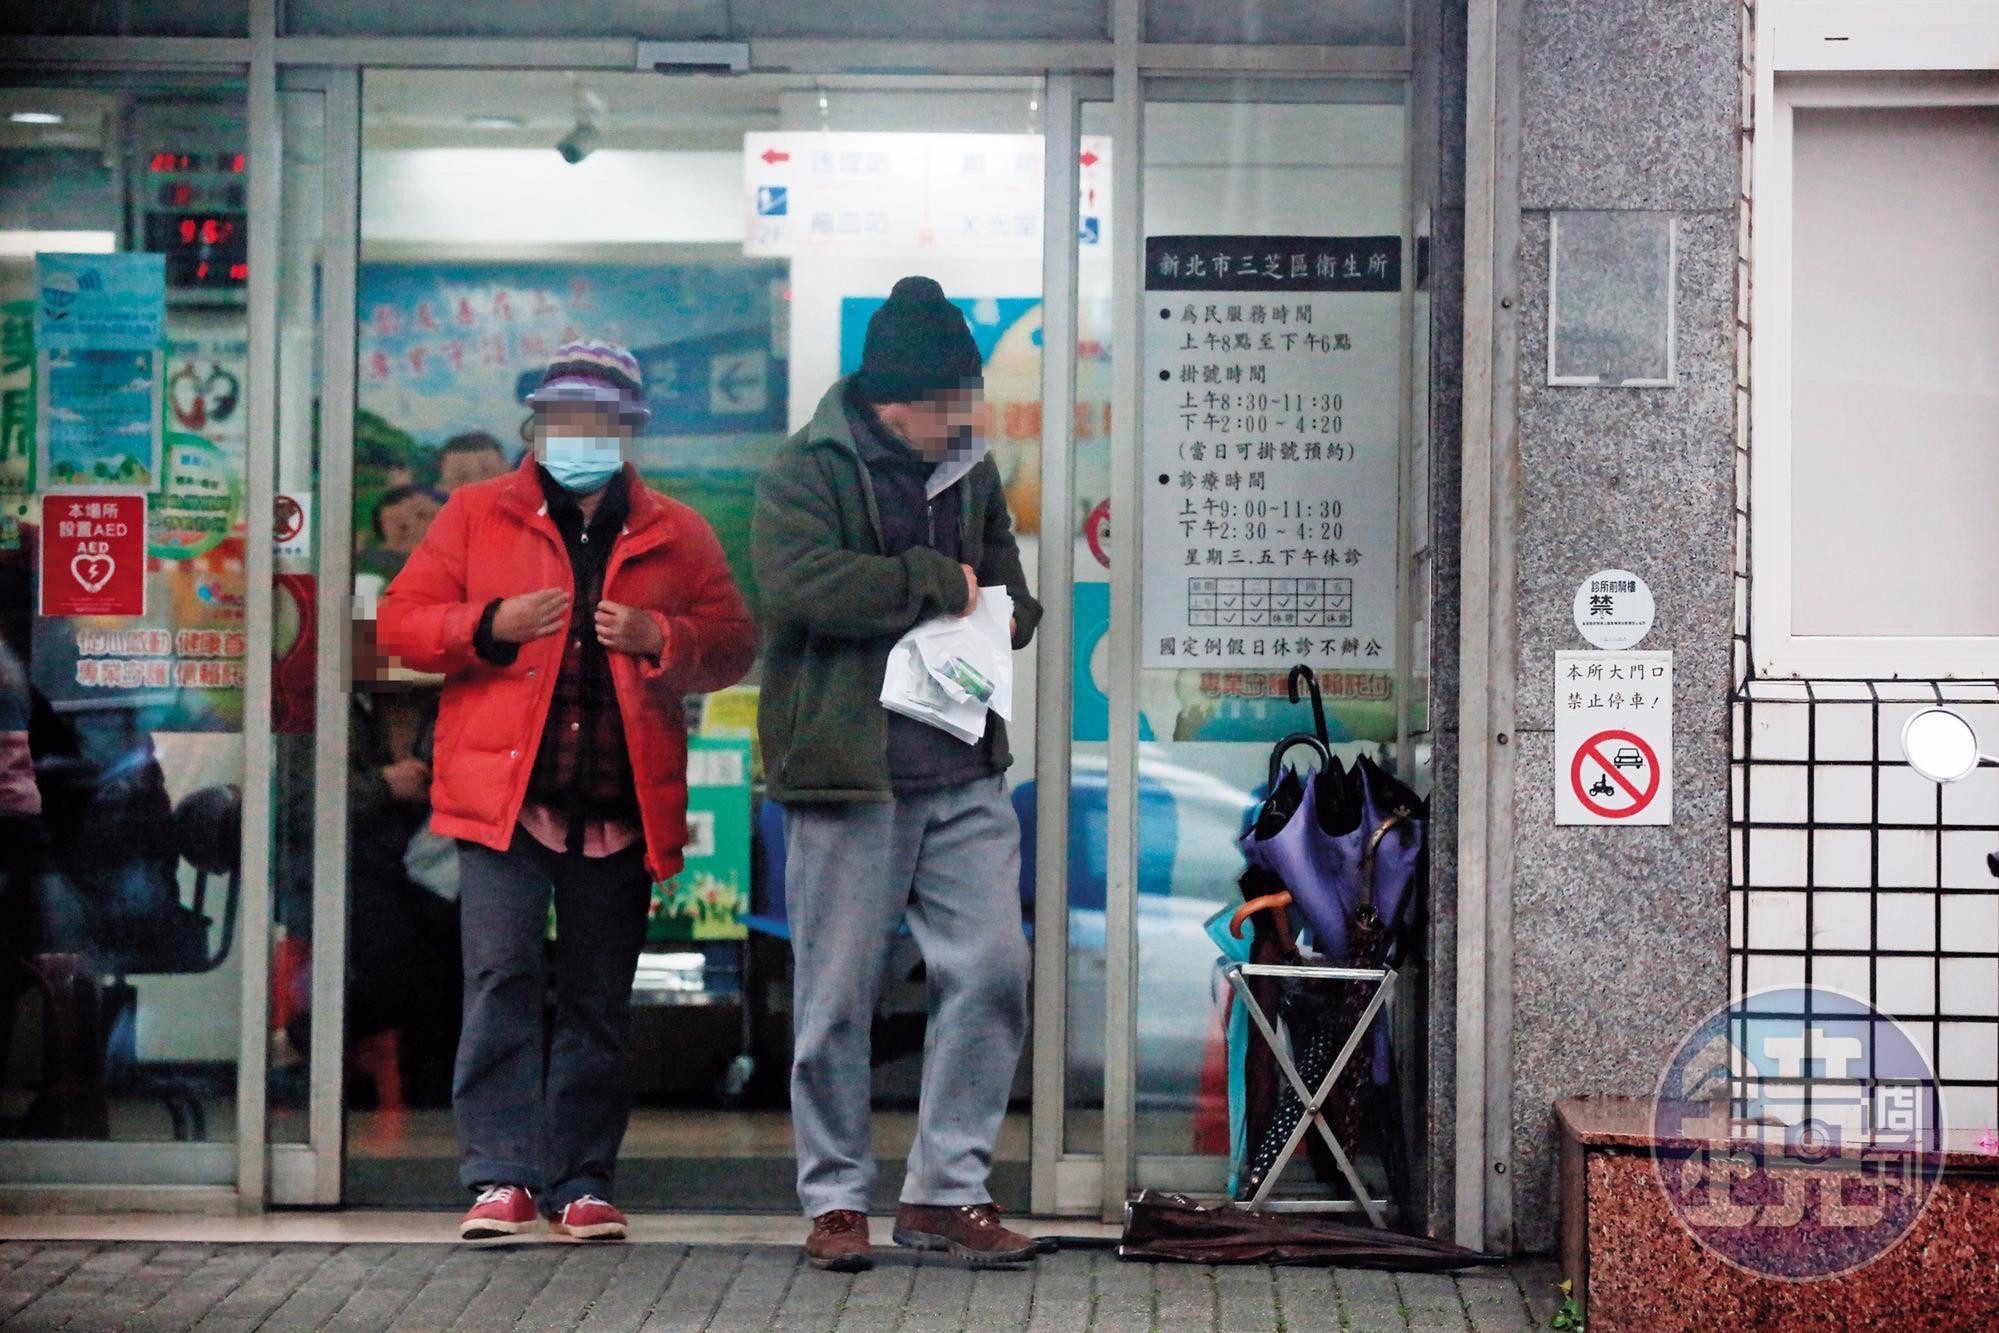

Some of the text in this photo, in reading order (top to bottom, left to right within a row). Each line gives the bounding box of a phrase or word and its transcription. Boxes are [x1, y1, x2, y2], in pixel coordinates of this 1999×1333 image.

[1159, 253, 1389, 279] 新北市三芝區衛生所
[1180, 332, 1352, 352] 上午8點至下午6點
[1179, 365, 1266, 384] 掛號時間
[1178, 470, 1266, 490] 診療時間
[68, 503, 119, 519] 本場所
[59, 521, 128, 538] 設置AED
[76, 541, 109, 554] AED
[1590, 580, 1637, 593] 診所前騎樓
[1160, 637, 1383, 656] 國定例假日休診不辦公
[1566, 664, 1664, 681] 本所大門口
[1567, 692, 1660, 710] 禁止停車!
